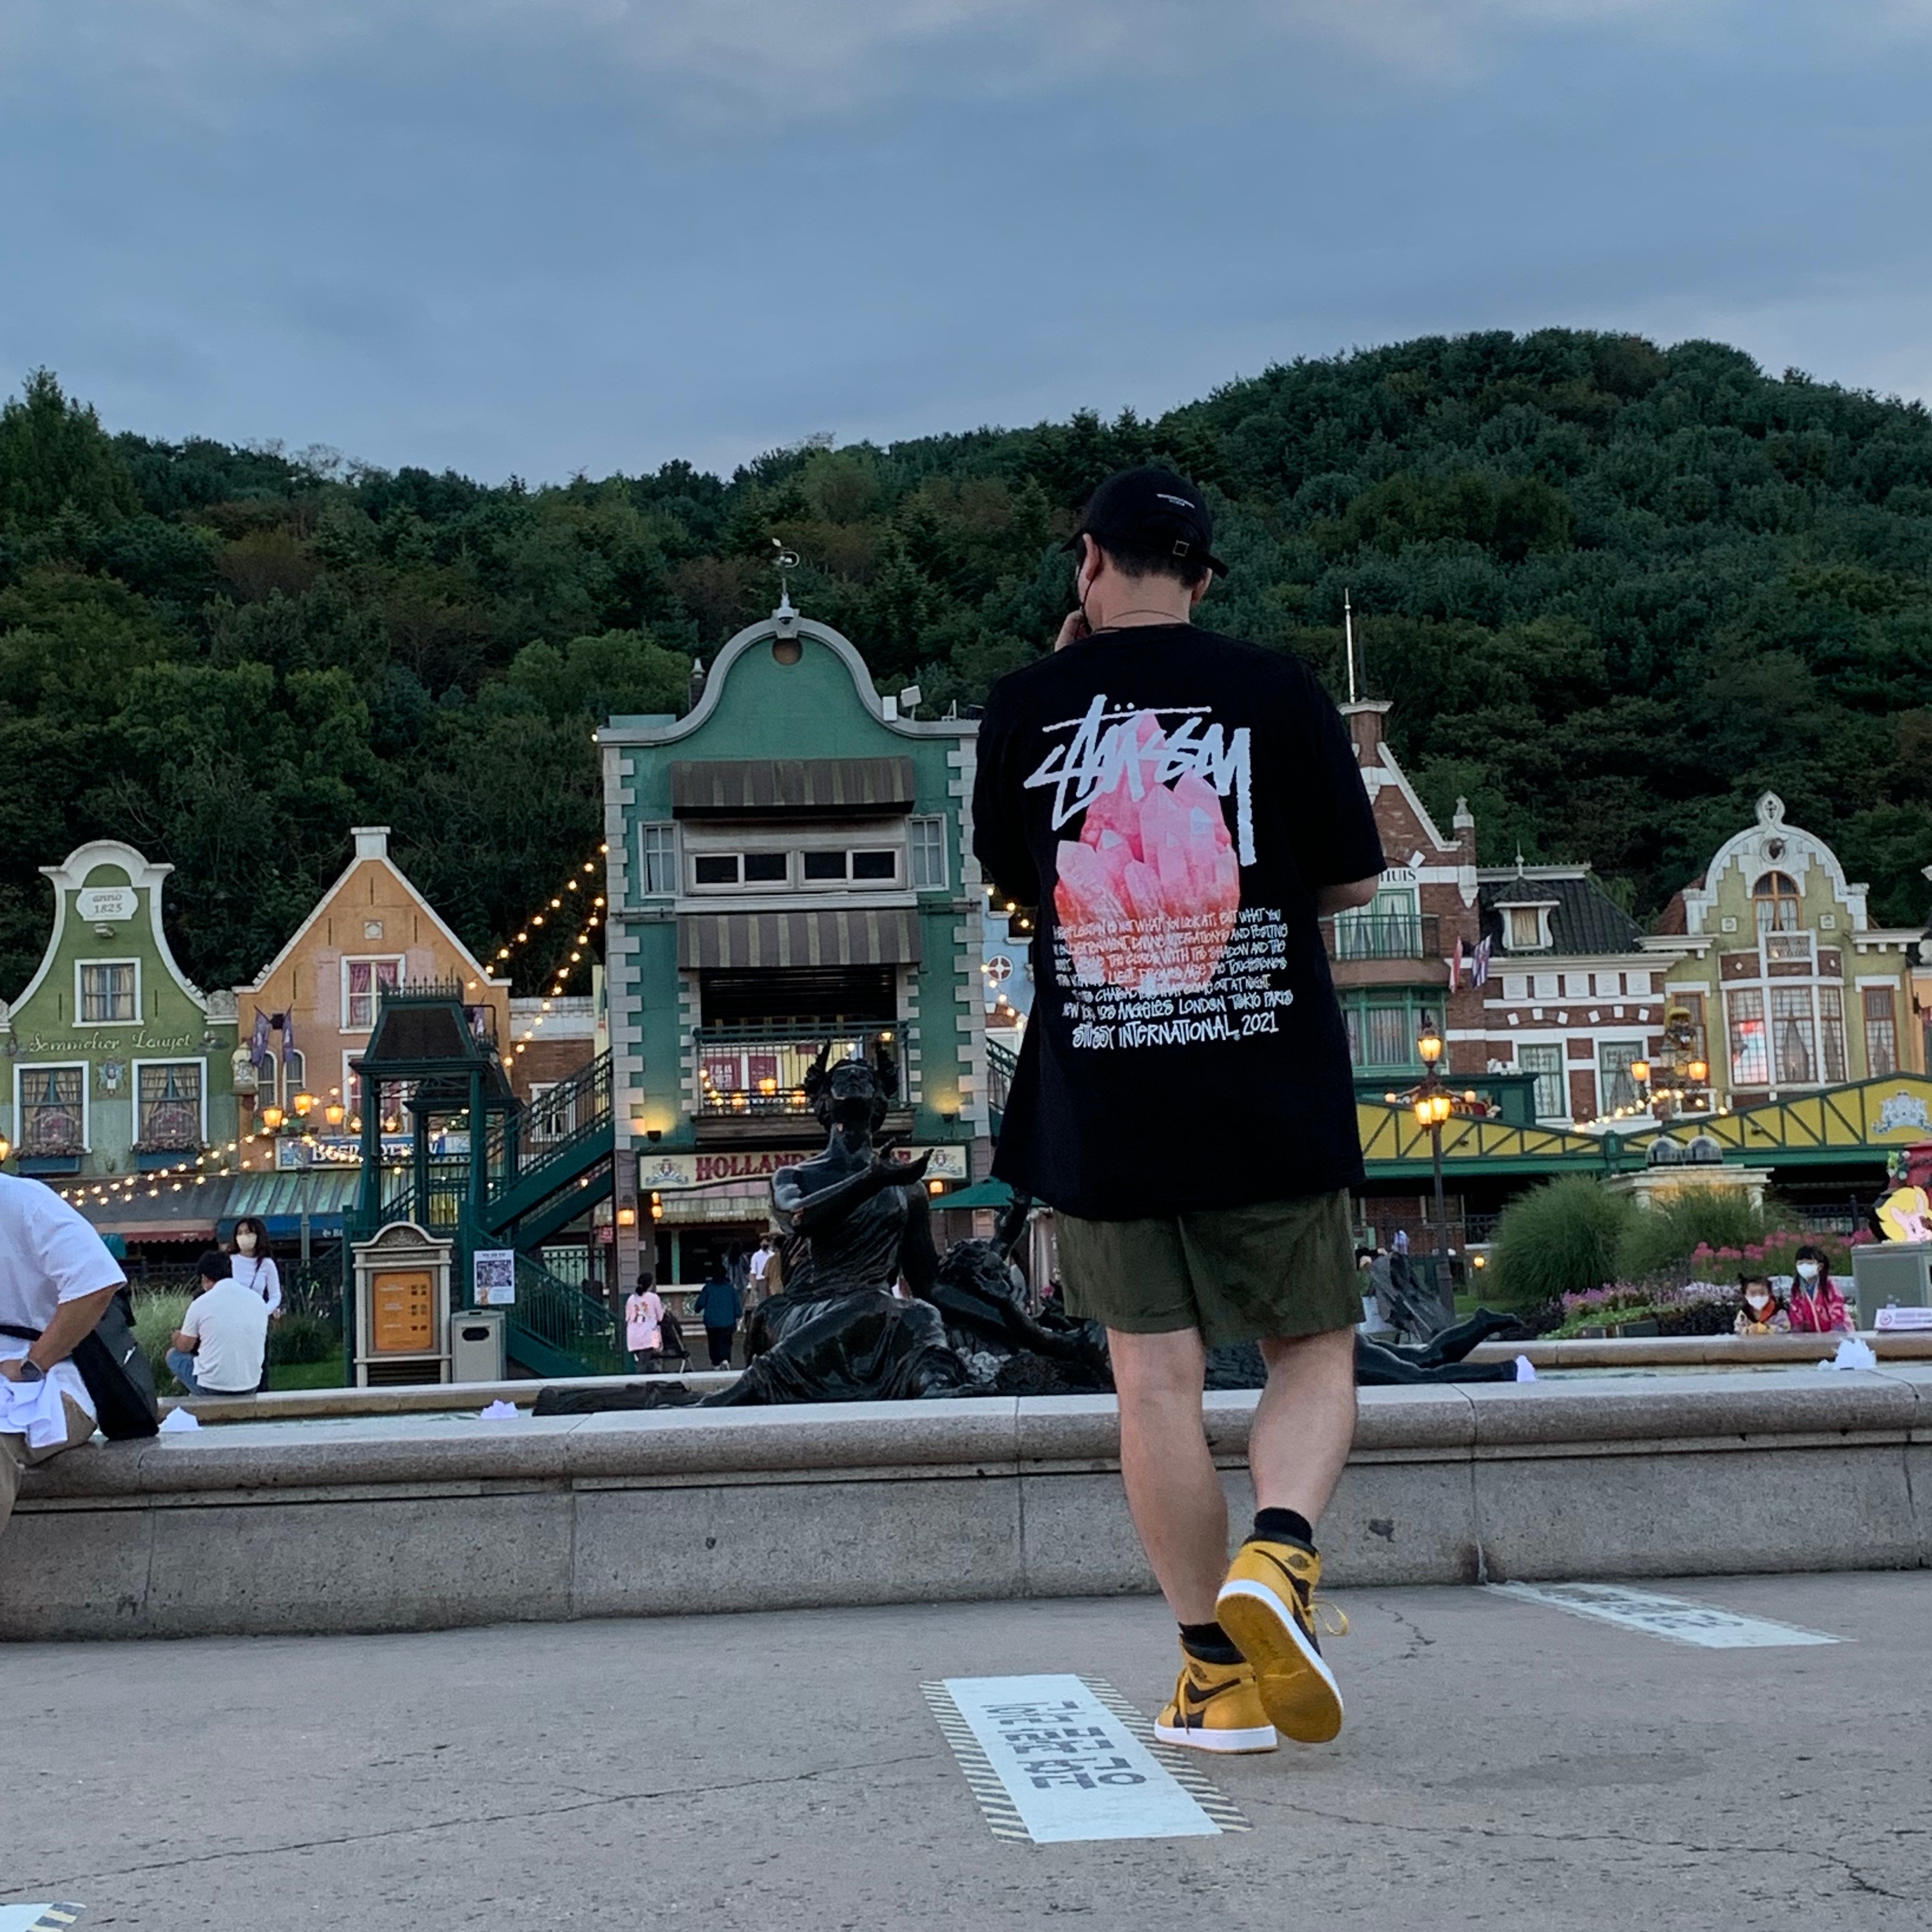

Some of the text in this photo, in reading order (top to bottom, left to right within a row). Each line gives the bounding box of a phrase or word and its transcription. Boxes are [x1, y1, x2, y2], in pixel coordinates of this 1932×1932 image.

[95, 902, 123, 914] 1825
[1140, 916, 1165, 933] WHAT
[1181, 914, 1200, 928] LOOK
[1219, 910, 1238, 926] BUT
[1238, 907, 1266, 924] WHAT
[1264, 908, 1281, 922] YOU
[1230, 928, 1250, 942] AND
[1208, 941, 1250, 959] SHADOW
[1250, 942, 1269, 956] AND
[1179, 995, 1227, 1015] LONDON
[1227, 991, 1261, 1010] TOKYO
[1263, 989, 1294, 1008] PARIS
[1241, 1010, 1280, 1036] 2021
[1016, 1756, 1147, 1790] 공연
